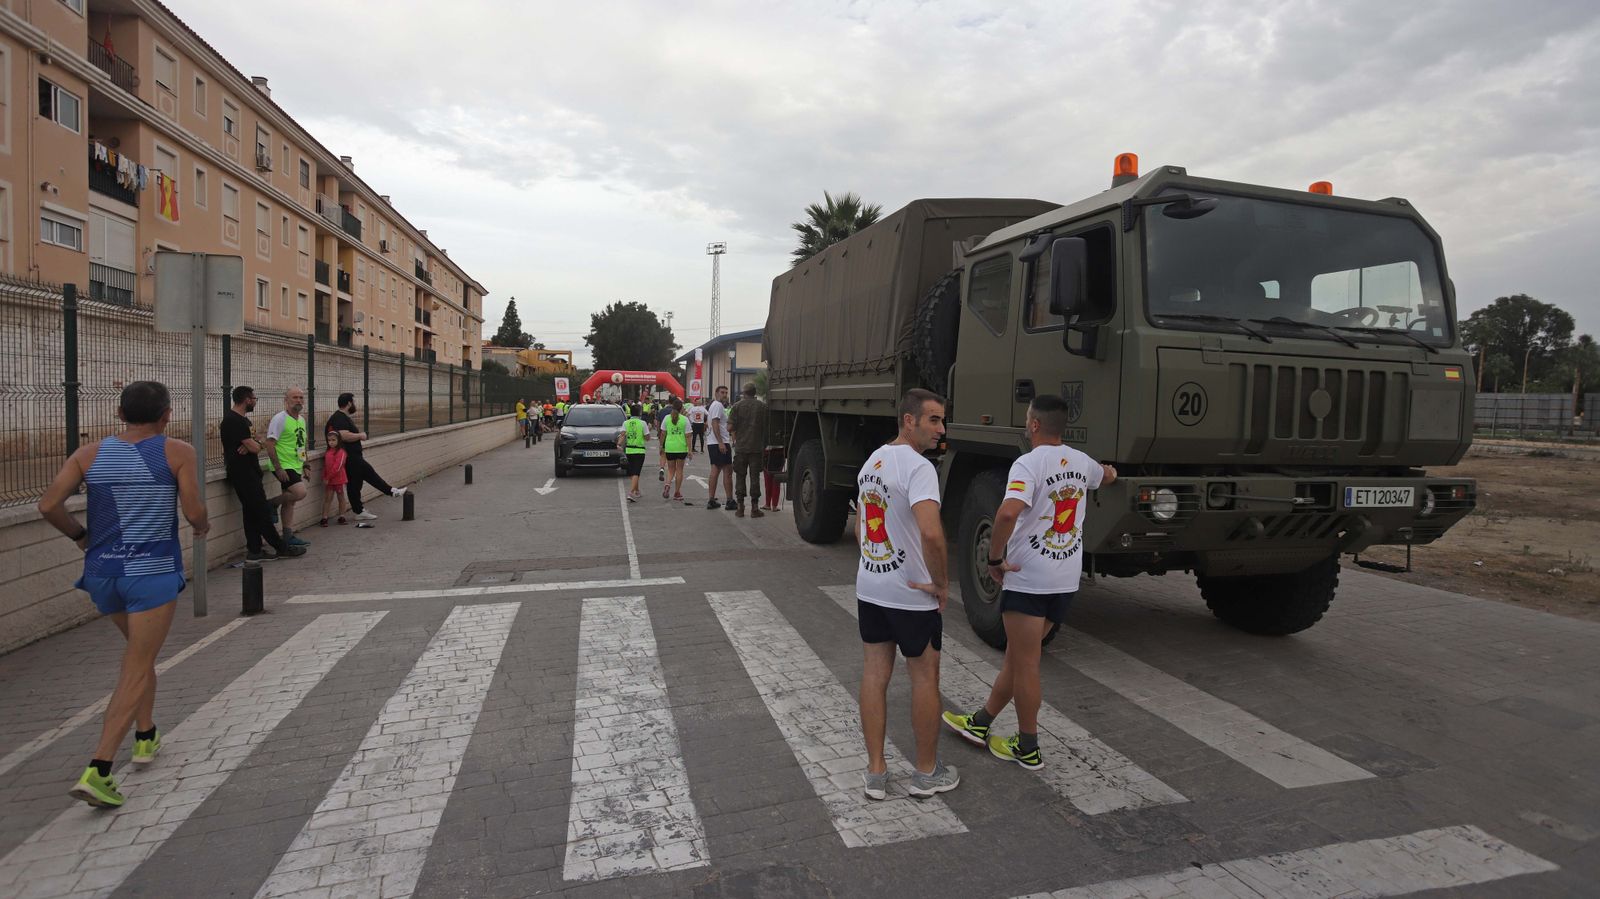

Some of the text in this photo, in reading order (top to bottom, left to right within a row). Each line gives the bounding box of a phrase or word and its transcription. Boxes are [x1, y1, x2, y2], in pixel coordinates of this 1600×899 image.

[1178, 391, 1202, 416] 20
[1356, 489, 1410, 504] ET120347
[1029, 534, 1040, 549] NO
